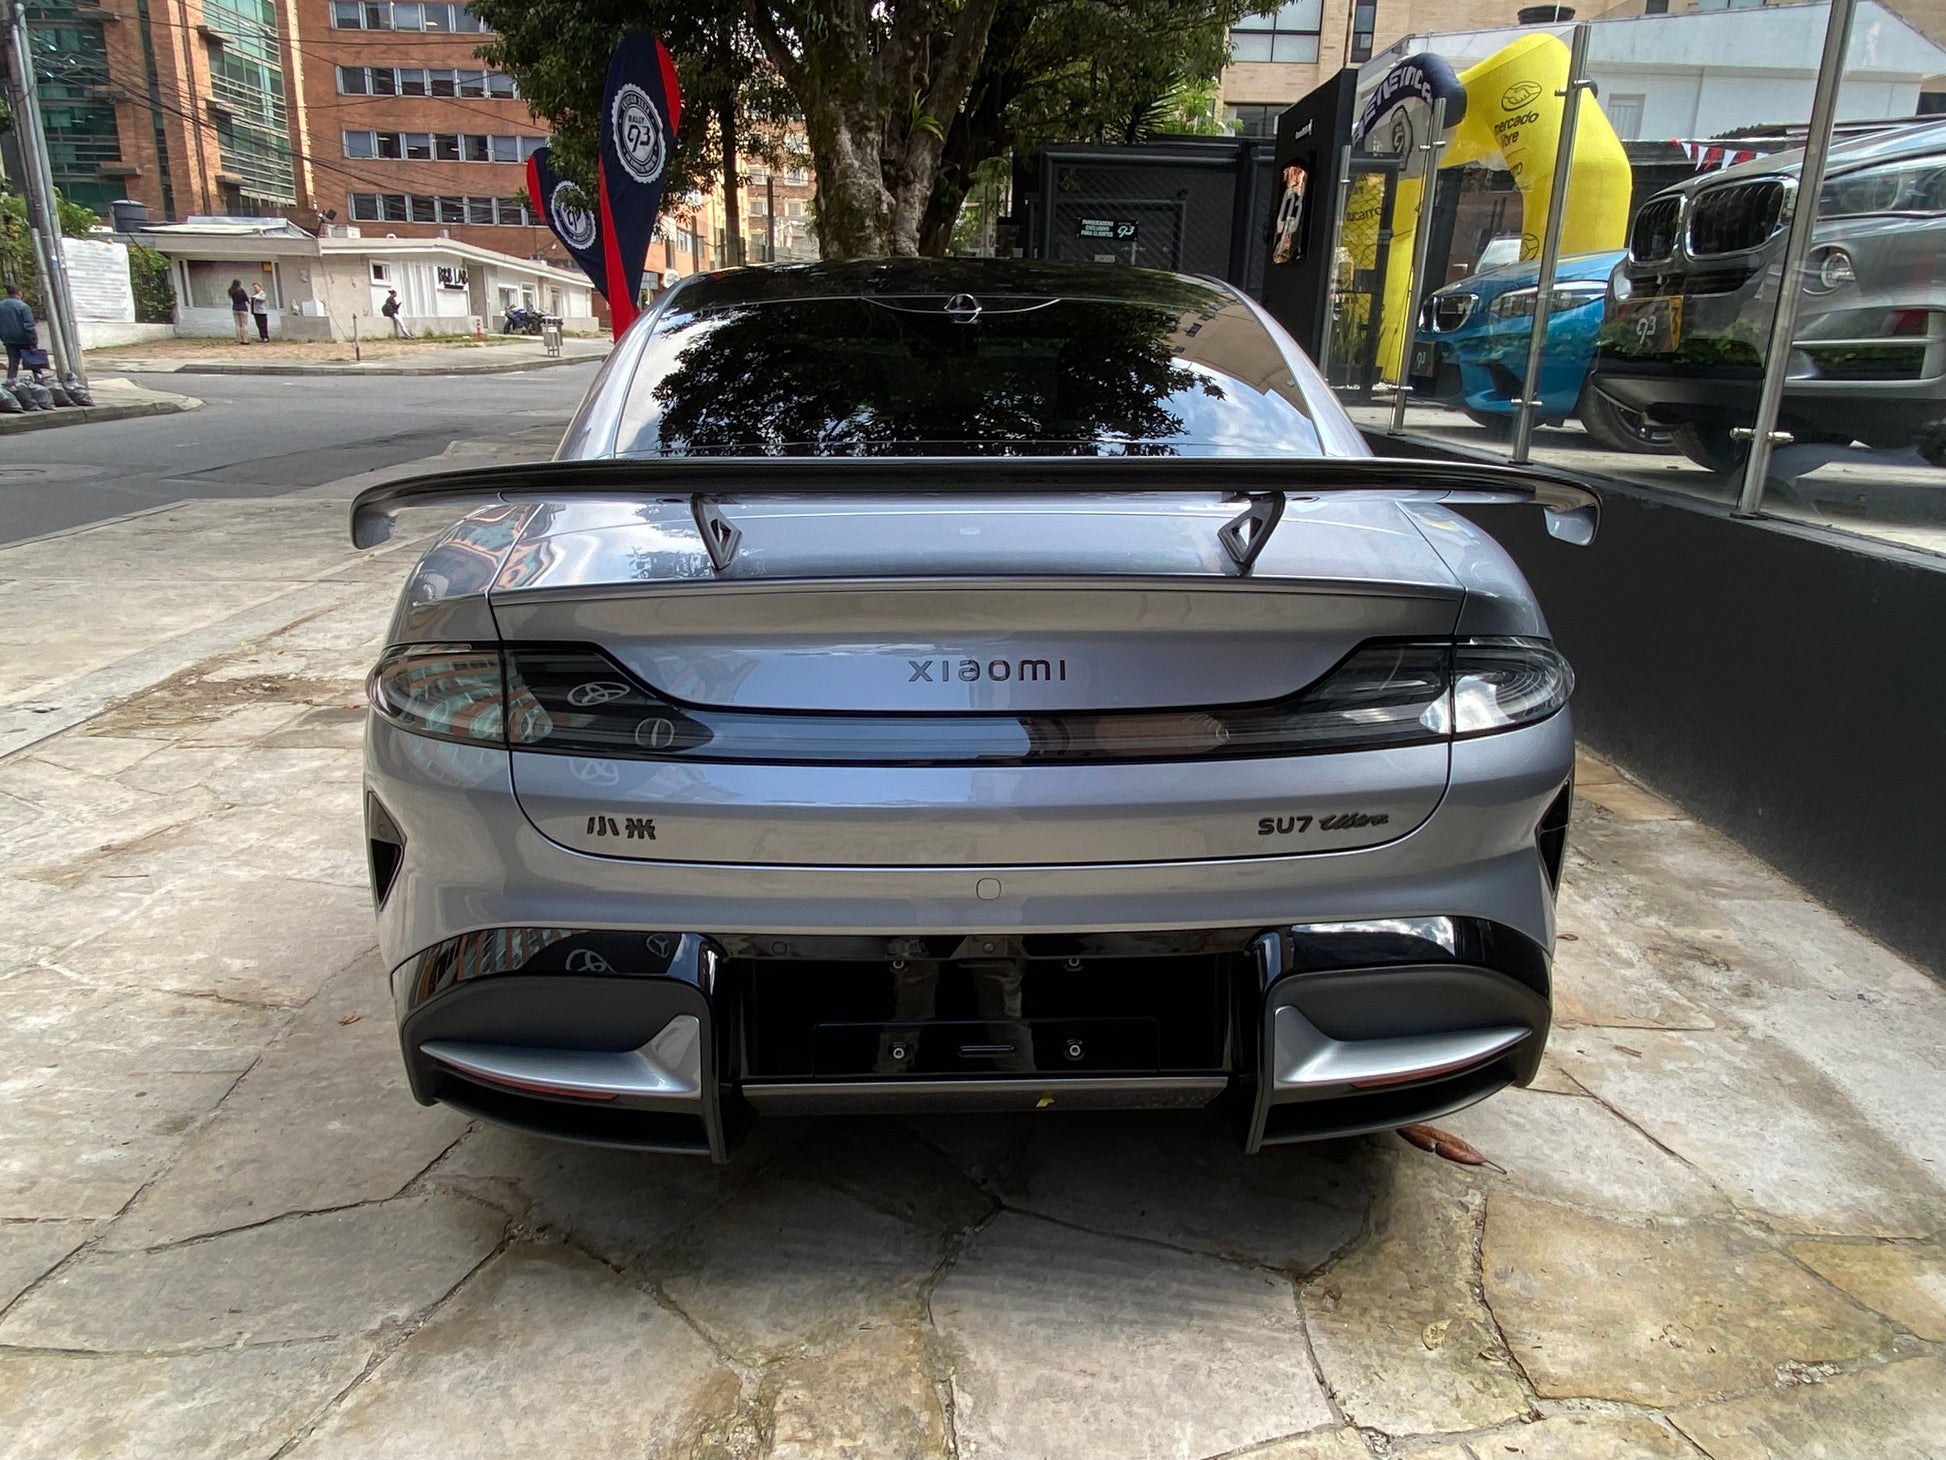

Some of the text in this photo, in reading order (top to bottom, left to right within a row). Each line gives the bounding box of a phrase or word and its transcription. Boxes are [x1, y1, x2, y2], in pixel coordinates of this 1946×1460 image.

[628, 114, 646, 124] RALLY
[627, 124, 652, 153] 93
[1117, 225, 1135, 238] 93
[1636, 315, 1656, 344] 93
[908, 659, 1067, 682] xiaomi
[586, 815, 657, 841] 小米
[1257, 814, 1314, 836] SU7
